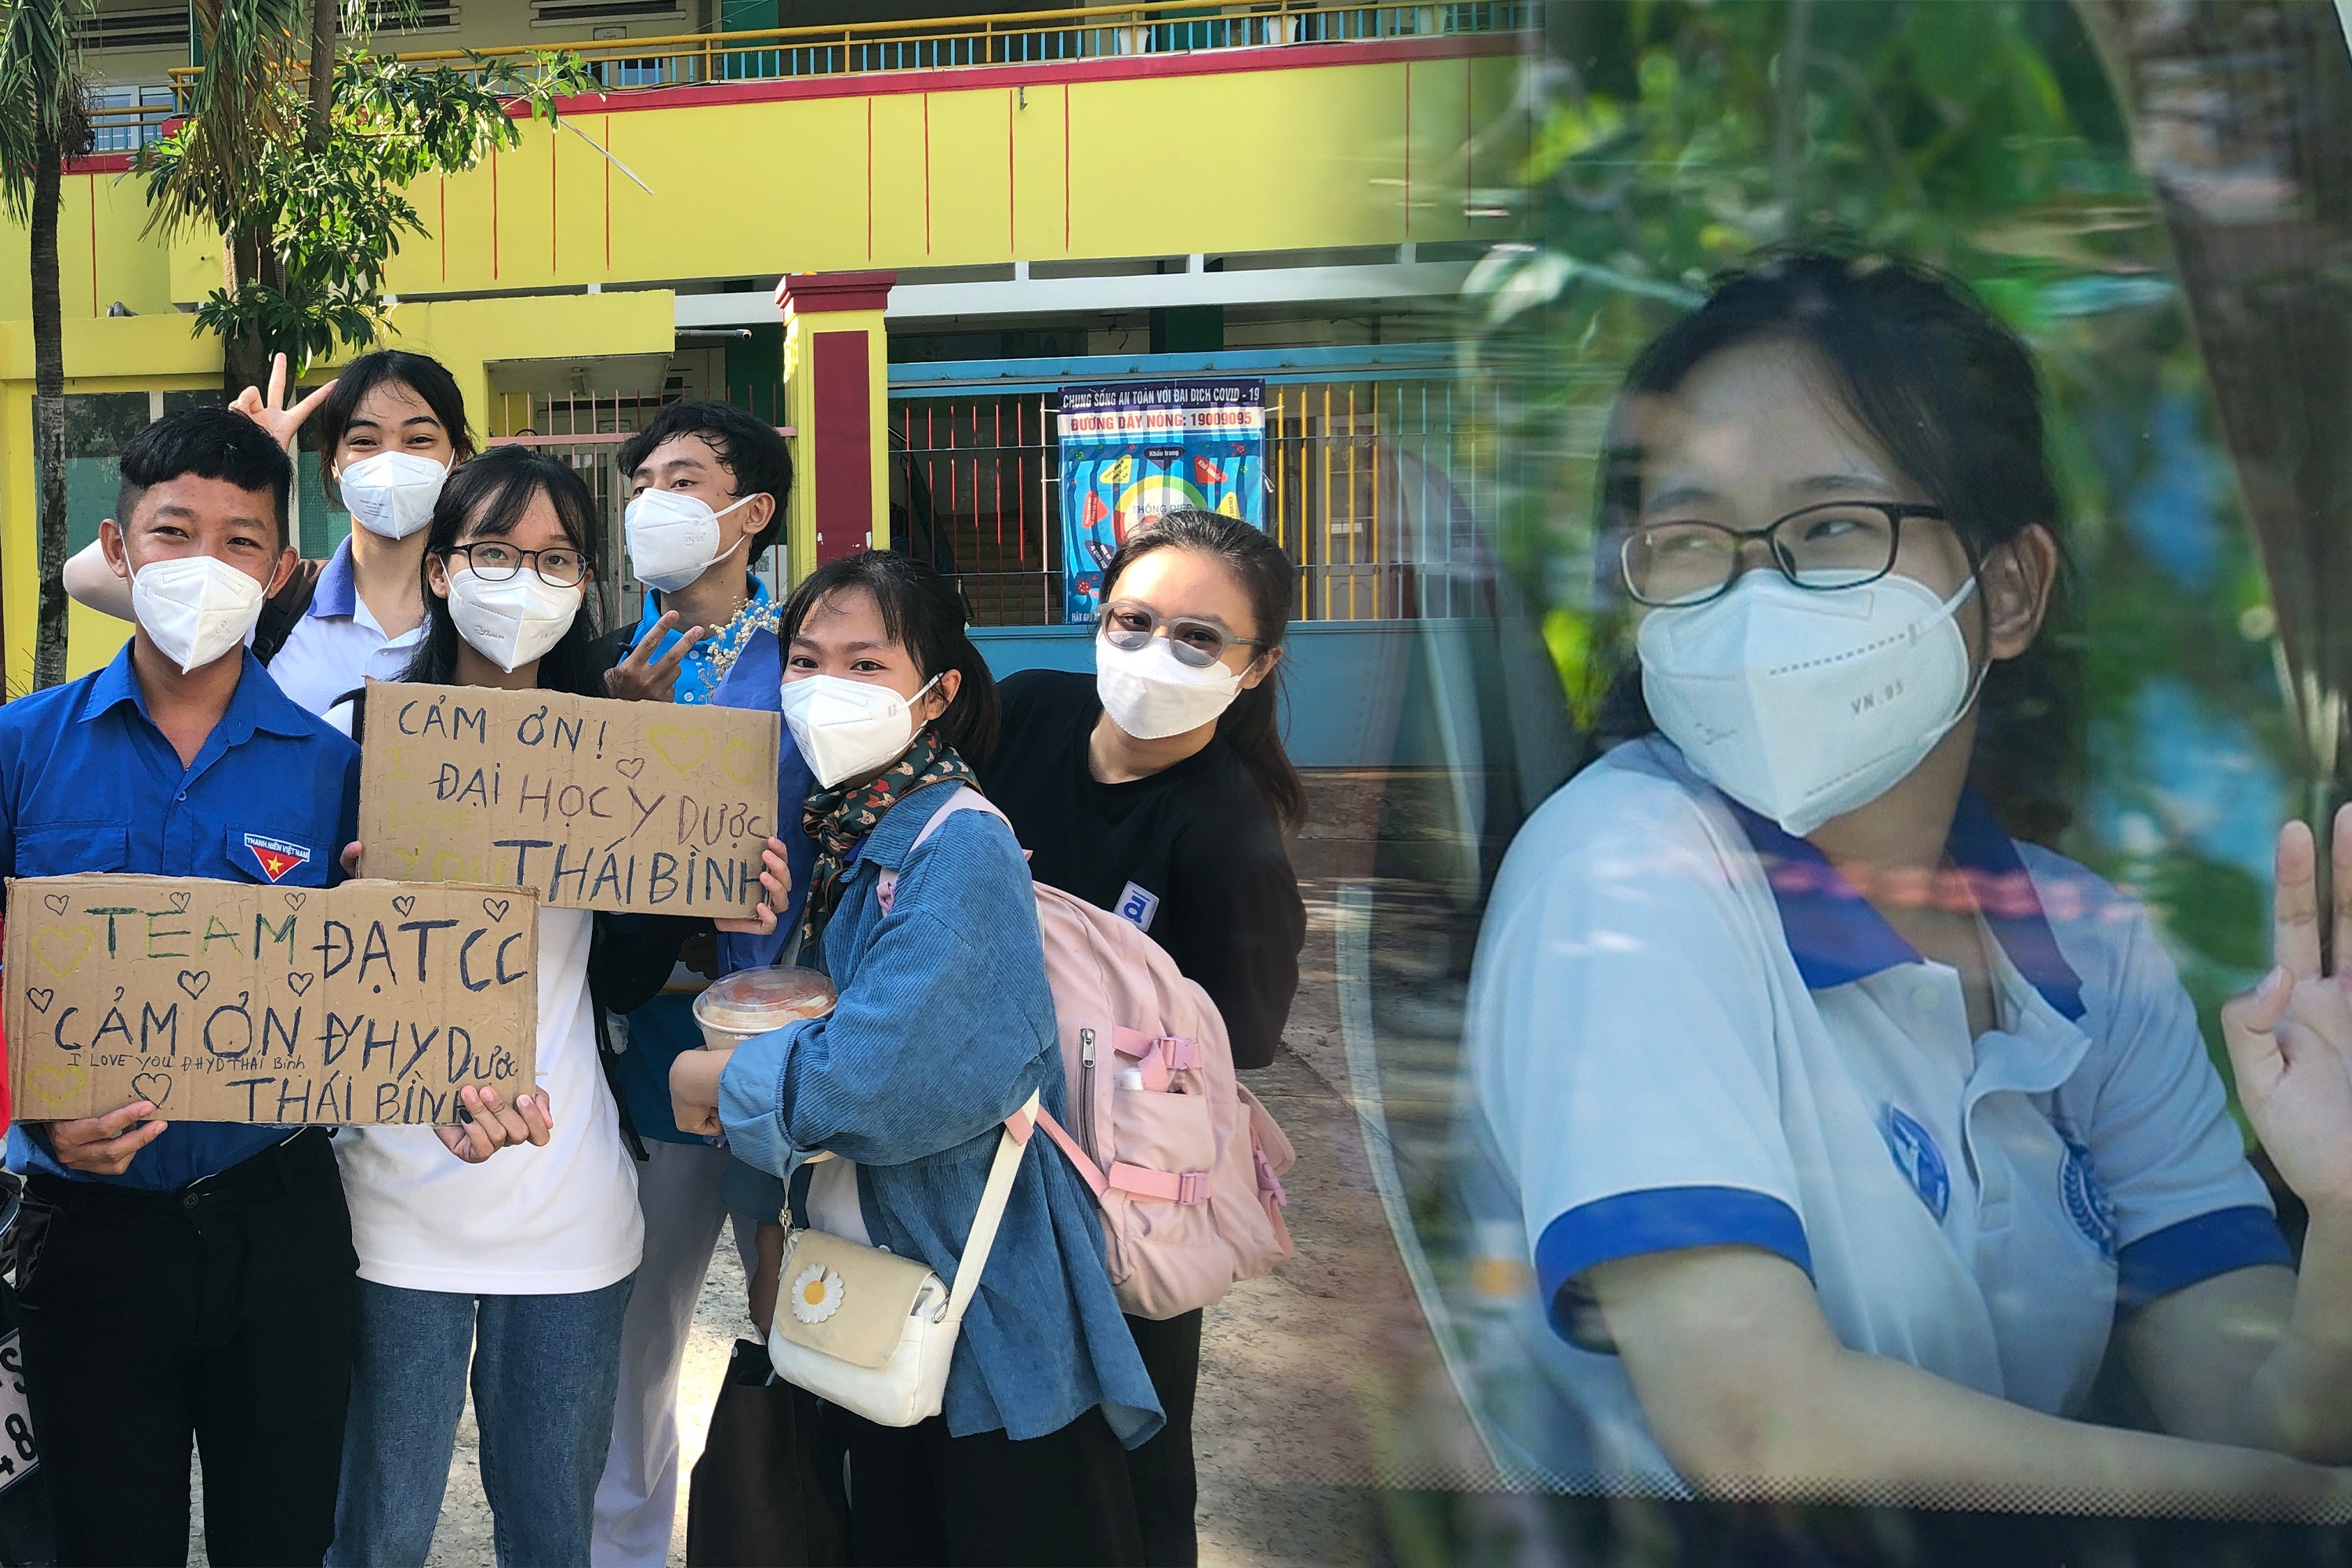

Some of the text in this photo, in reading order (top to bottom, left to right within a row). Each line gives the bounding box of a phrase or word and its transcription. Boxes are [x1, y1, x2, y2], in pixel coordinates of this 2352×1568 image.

[1063, 394, 1092, 408] CHUNG
[1094, 388, 1116, 407] SỐNG
[1119, 391, 1130, 405] AN
[1133, 387, 1155, 405] TOÀN
[1157, 386, 1171, 404] VỚI
[1173, 387, 1188, 405] ĐẠI
[1191, 387, 1211, 405] DỊCH
[1213, 387, 1240, 401] COVID
[1249, 387, 1260, 401] 19
[1071, 415, 1114, 431] ĐƯỜNG
[1118, 413, 1142, 430] DÂY
[1191, 412, 1252, 426] 19009095
[1132, 503, 1167, 514] THÔNG
[398, 695, 487, 744] CẢM
[519, 774, 613, 827] HỌC
[627, 786, 665, 839] Y
[678, 794, 771, 849] DƯỢC
[246, 837, 309, 858] THANH NIÊN VIỆT NAM
[492, 836, 770, 906] THÁI BÌNH
[83, 906, 299, 964] TEAM
[55, 985, 179, 1057] CẢM
[67, 1053, 82, 1067] I
[89, 1054, 133, 1068] LOVE
[225, 1069, 353, 1123] THÁI
